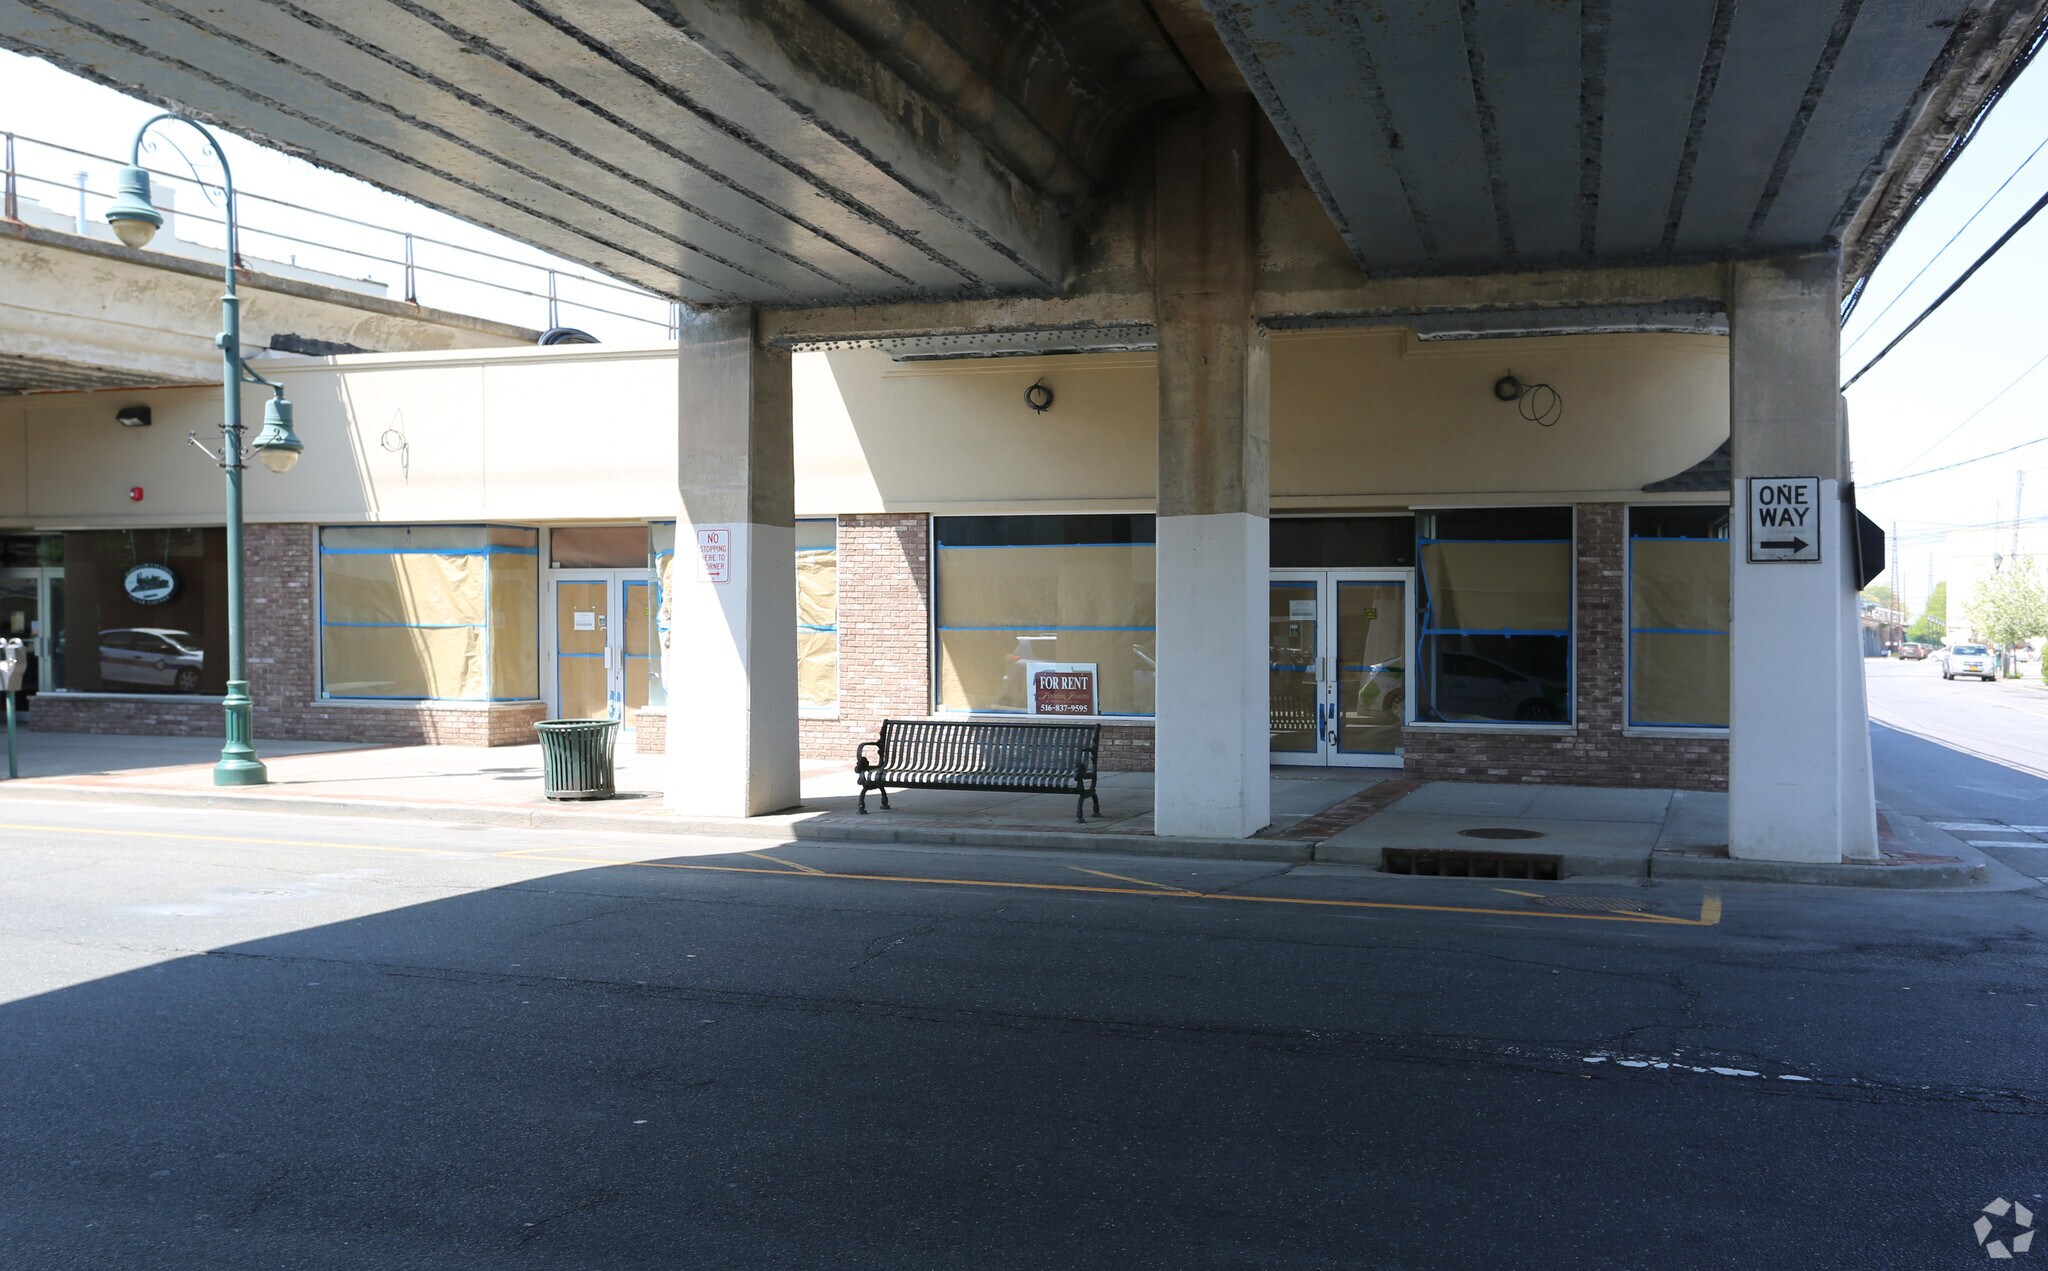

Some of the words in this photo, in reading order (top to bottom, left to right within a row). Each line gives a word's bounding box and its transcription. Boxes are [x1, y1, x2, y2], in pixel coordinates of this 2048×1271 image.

[1759, 485, 1808, 505] ONE
[1759, 507, 1810, 527] WAY
[707, 533, 719, 543] NO
[700, 545, 727, 553] STOPPING
[718, 553, 726, 562] TO
[705, 562, 725, 570] ORNER
[1040, 676, 1060, 690] FOR
[1061, 676, 1088, 690] RENT
[1040, 703, 1088, 713] 516-837-9595
